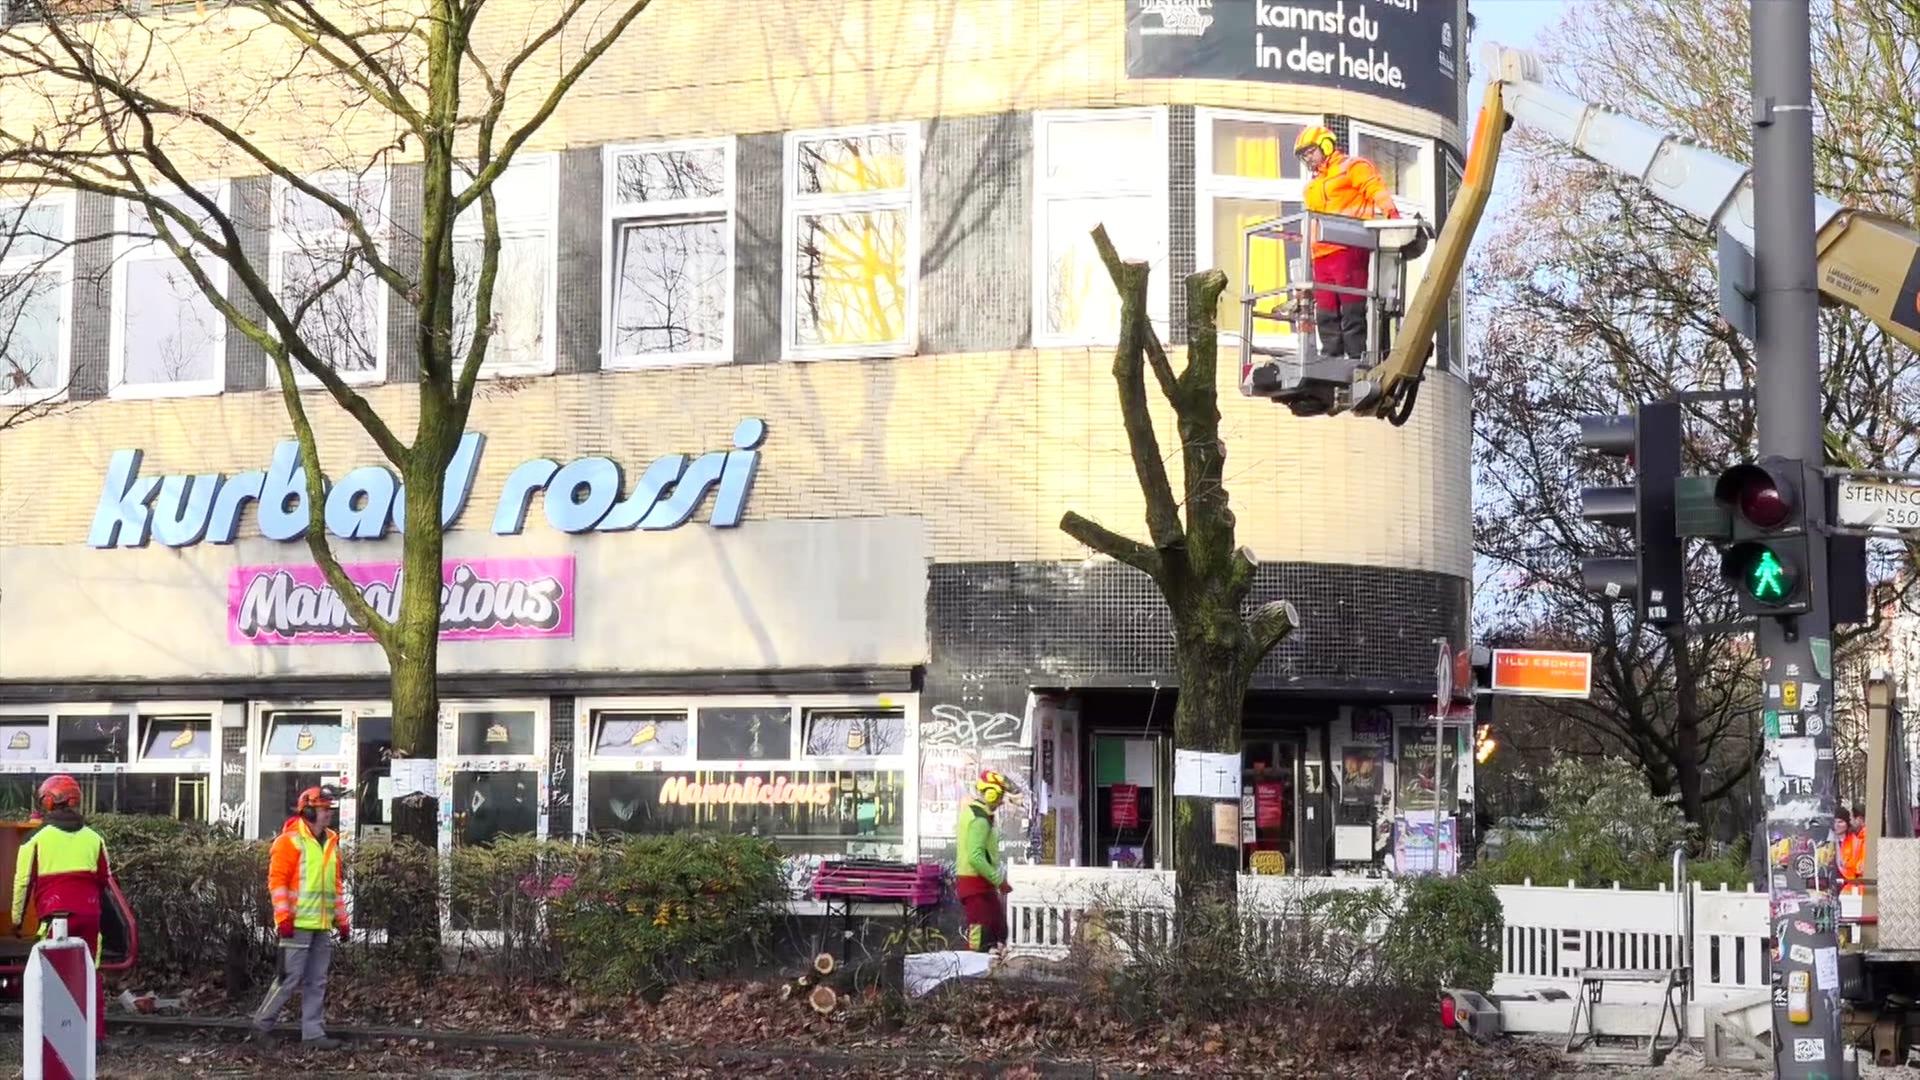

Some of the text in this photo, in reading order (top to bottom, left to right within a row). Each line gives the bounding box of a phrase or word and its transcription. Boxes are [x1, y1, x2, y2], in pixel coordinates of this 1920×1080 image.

[1256, 0, 1379, 41] kannst du
[1286, 36, 1336, 74] der
[491, 418, 766, 535] rossi
[659, 775, 832, 806] Mamalicious
